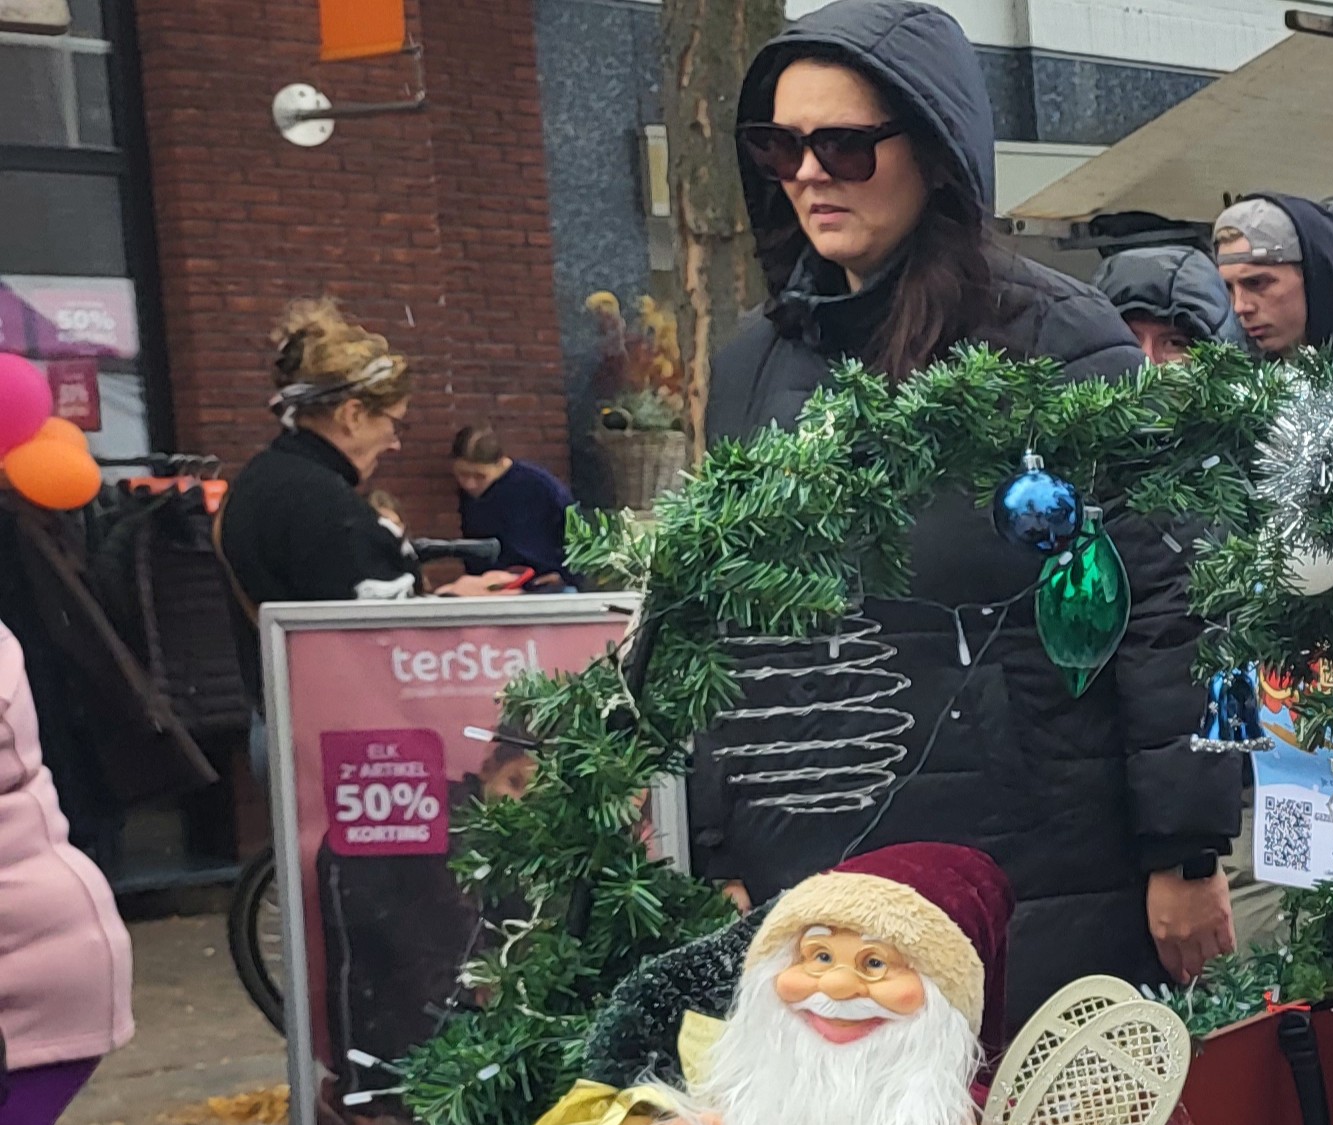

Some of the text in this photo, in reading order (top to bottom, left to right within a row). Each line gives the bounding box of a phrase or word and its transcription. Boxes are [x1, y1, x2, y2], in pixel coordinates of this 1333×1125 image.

[391, 639, 538, 682] terStal
[336, 781, 440, 822] 50%
[345, 824, 431, 843] KORTING
